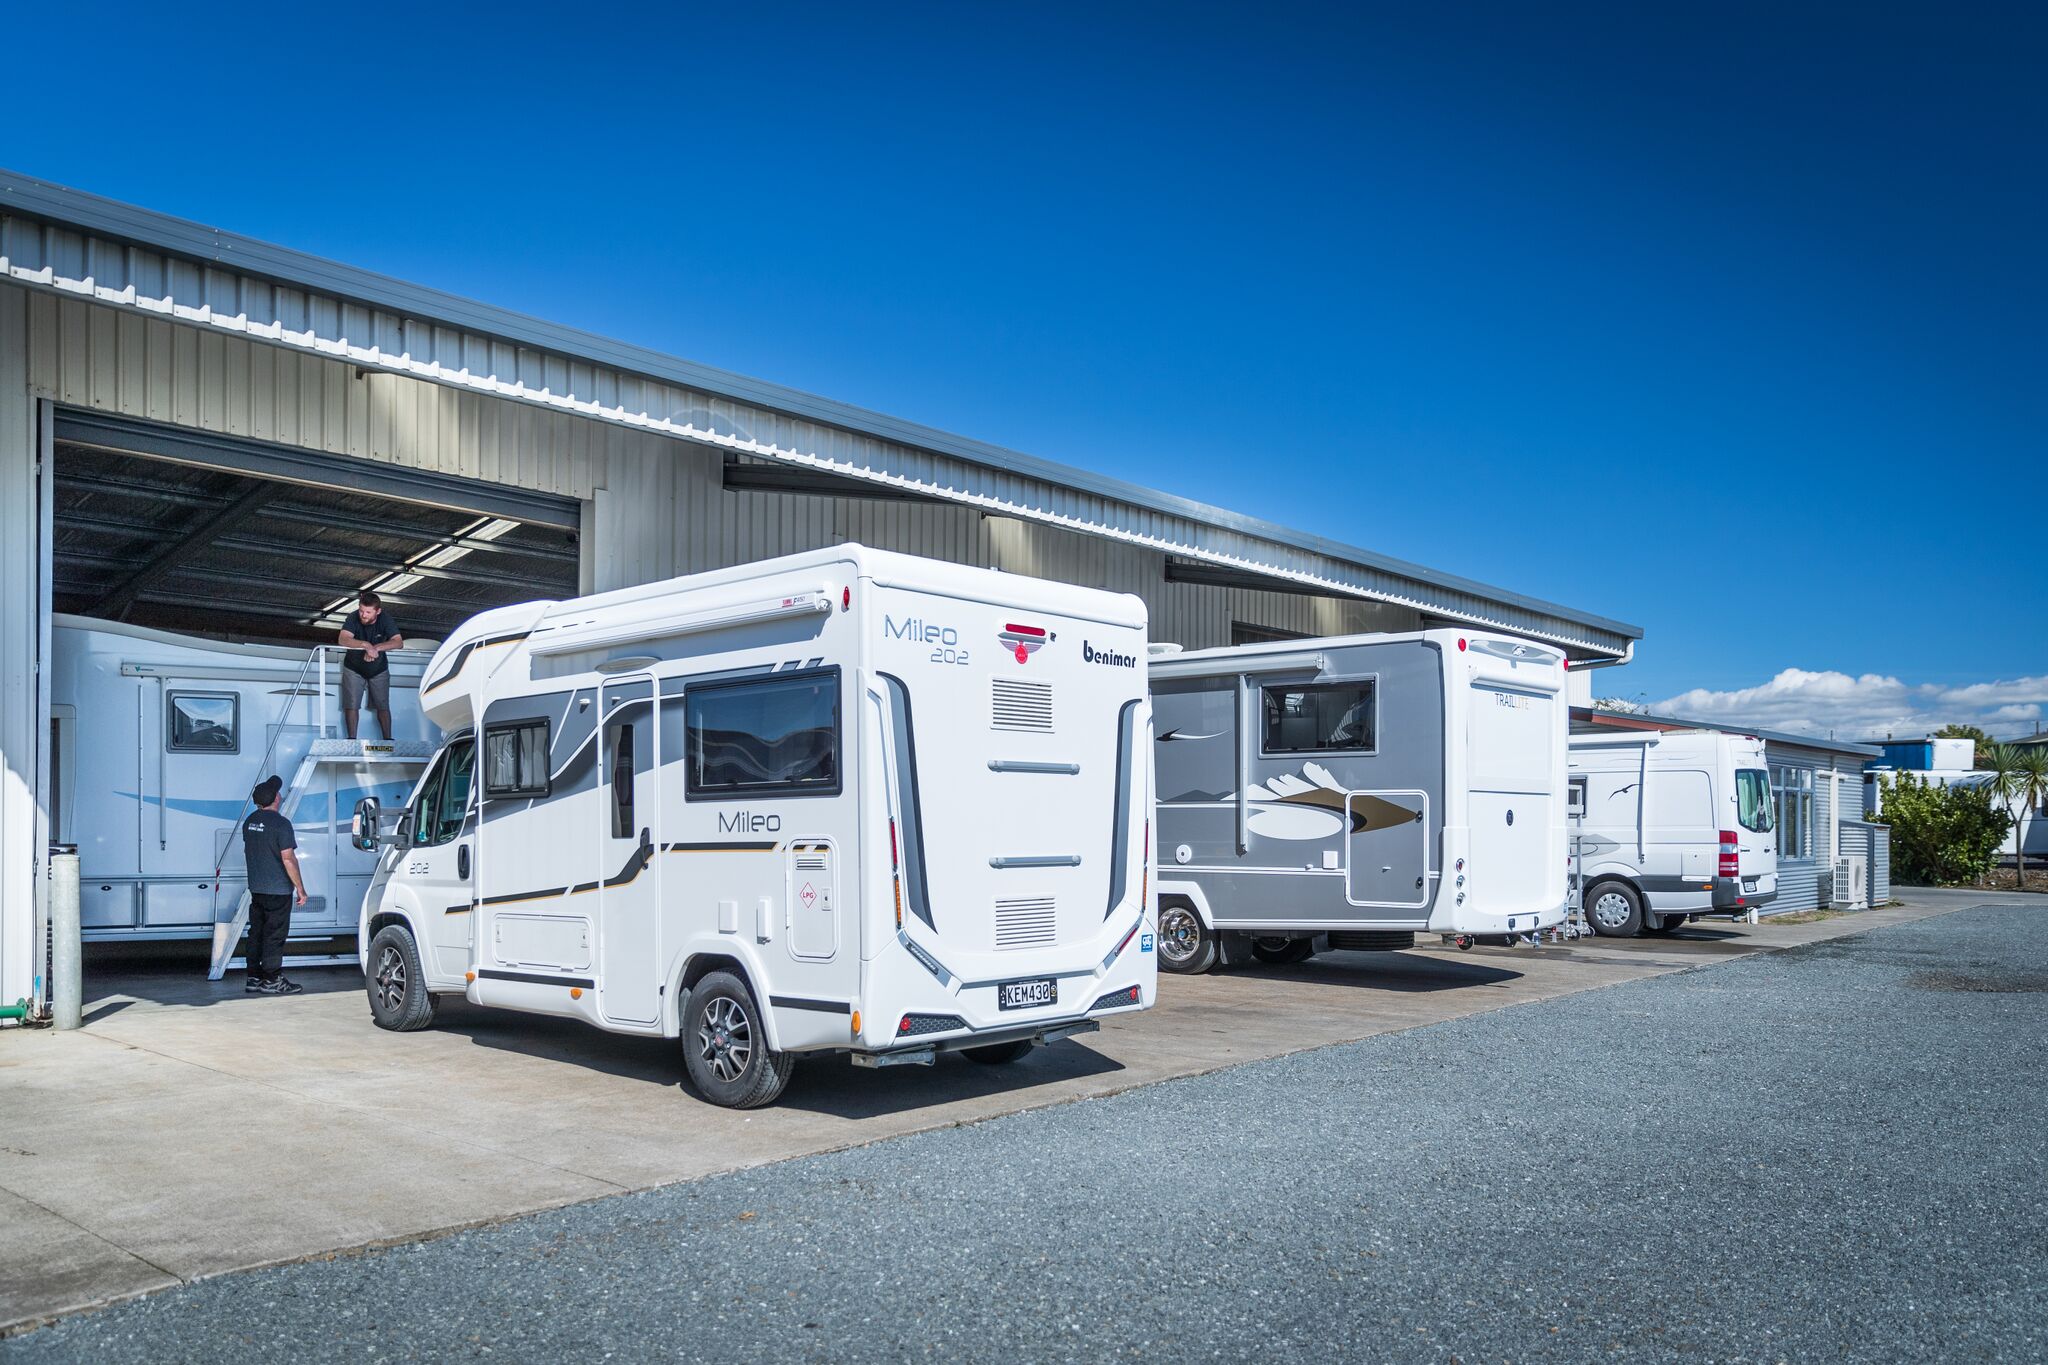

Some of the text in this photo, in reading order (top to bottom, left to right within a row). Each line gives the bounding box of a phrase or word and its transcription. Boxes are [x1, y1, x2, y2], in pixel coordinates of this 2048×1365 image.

[885, 614, 957, 645] Mileo
[931, 648, 968, 665] 202
[1083, 639, 1136, 668] benimar
[719, 810, 781, 833] Mileo
[409, 862, 429, 874] 202
[1007, 984, 1050, 1004] KEM430
